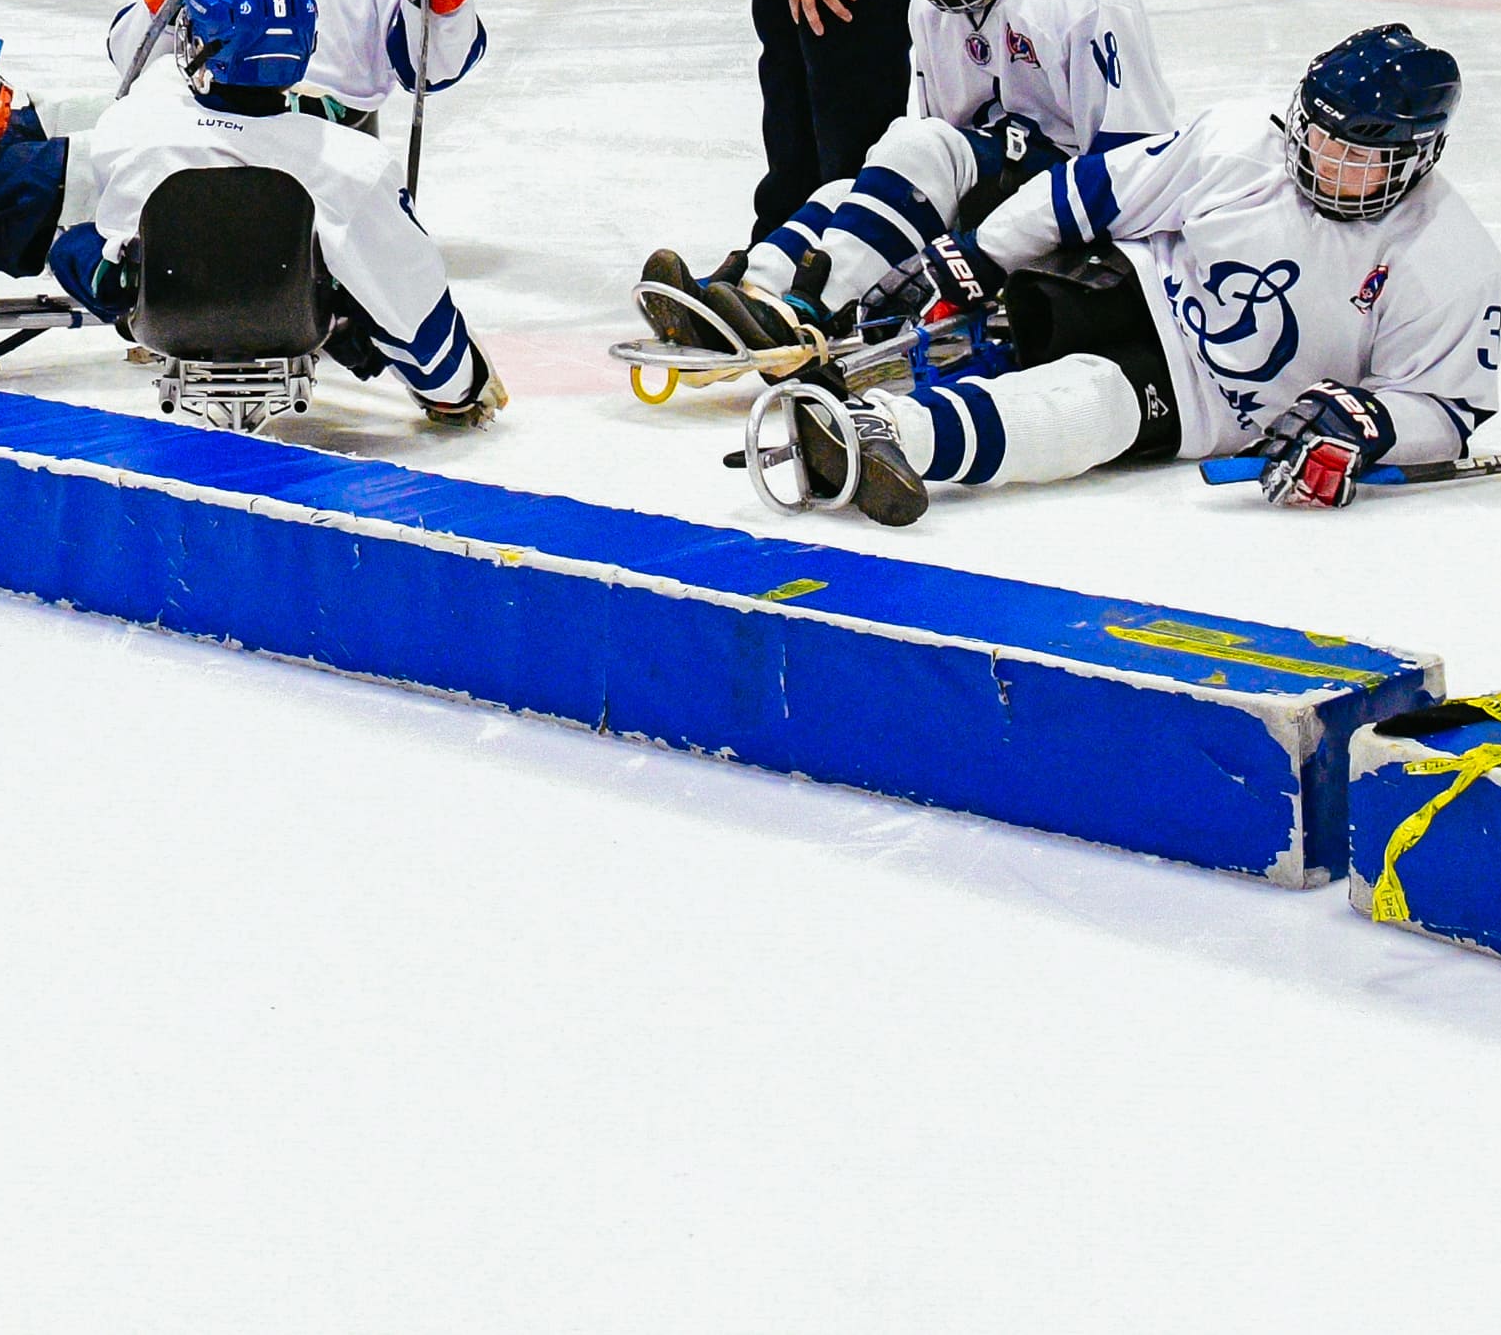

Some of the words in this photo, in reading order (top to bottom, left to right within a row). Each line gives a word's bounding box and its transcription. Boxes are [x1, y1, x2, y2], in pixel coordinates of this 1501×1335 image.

[197, 118, 244, 132] LUTCH
[1313, 97, 1346, 121] CCM
[931, 234, 986, 302] UER
[1307, 378, 1382, 441] UER
